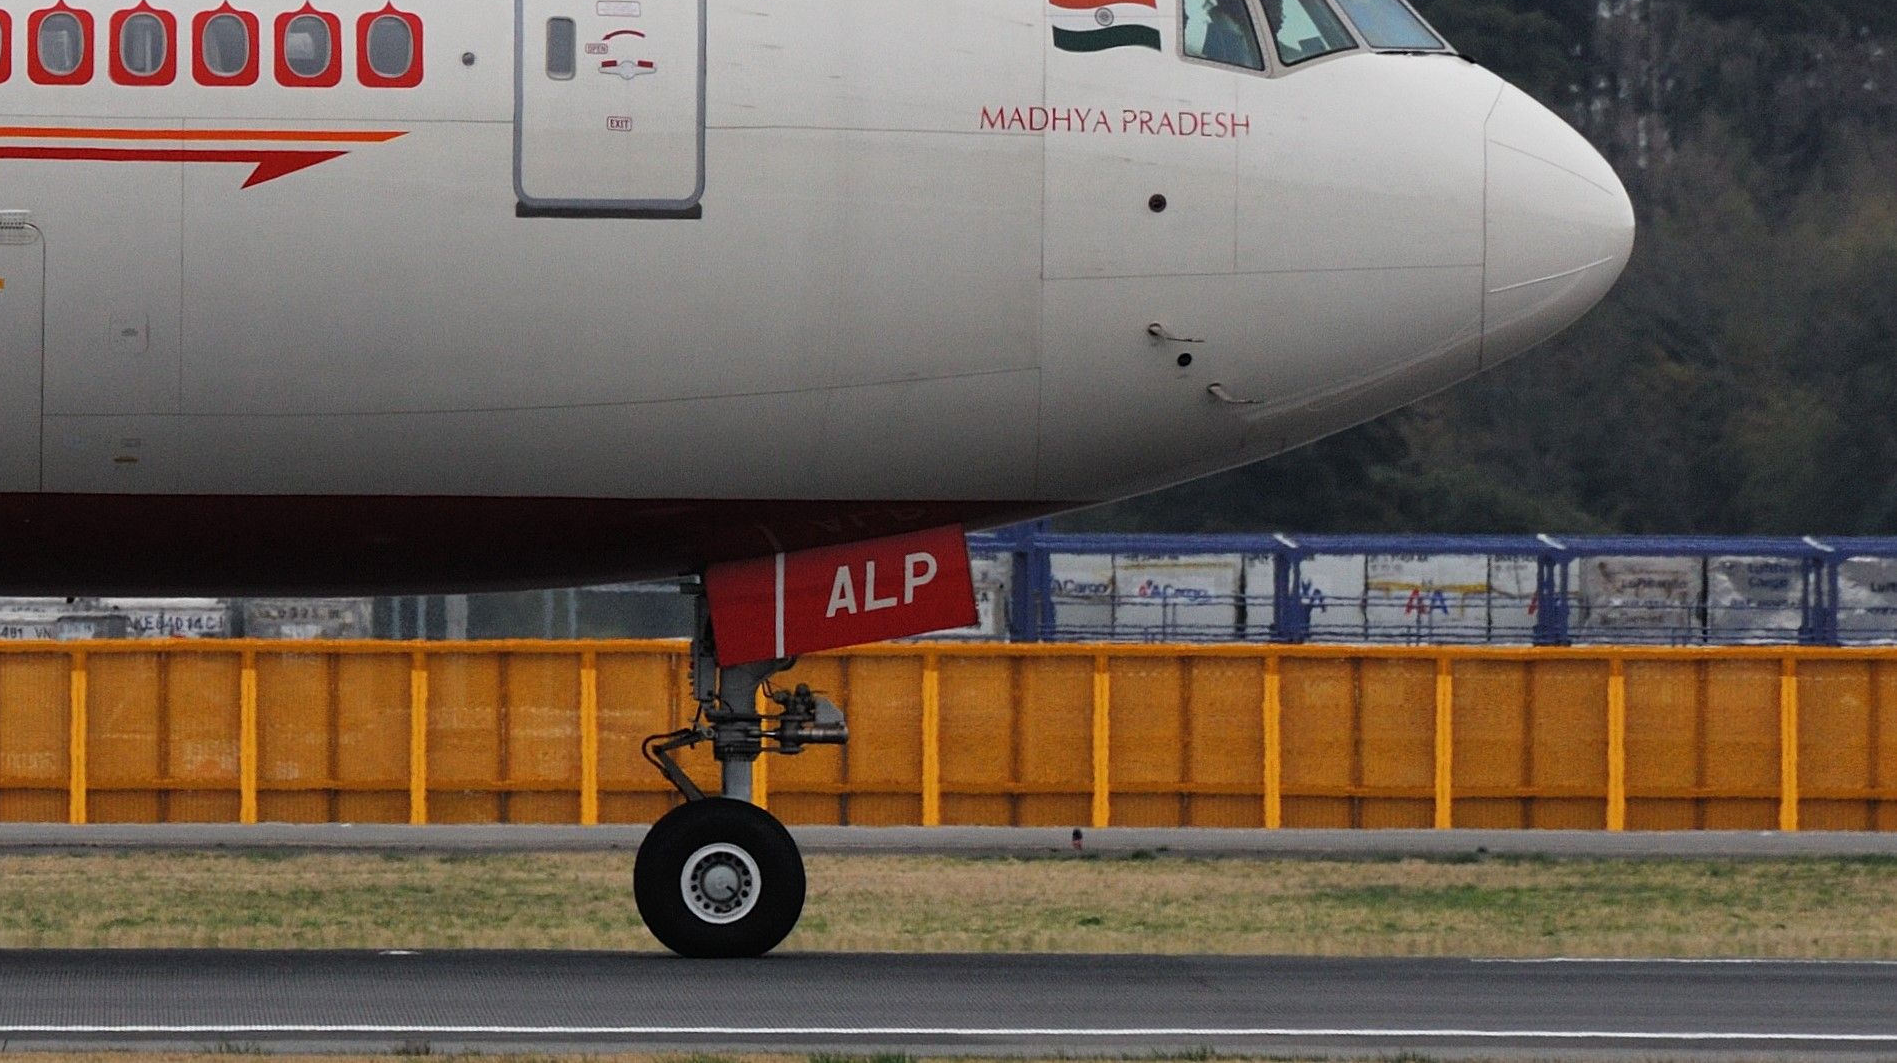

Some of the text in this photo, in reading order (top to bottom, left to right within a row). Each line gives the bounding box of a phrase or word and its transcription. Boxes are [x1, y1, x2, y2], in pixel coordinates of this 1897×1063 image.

[588, 44, 607, 53] OPEN
[610, 118, 630, 130] EXIT
[980, 105, 1251, 138] MADHYA PRADESH
[825, 551, 938, 618] ALP
